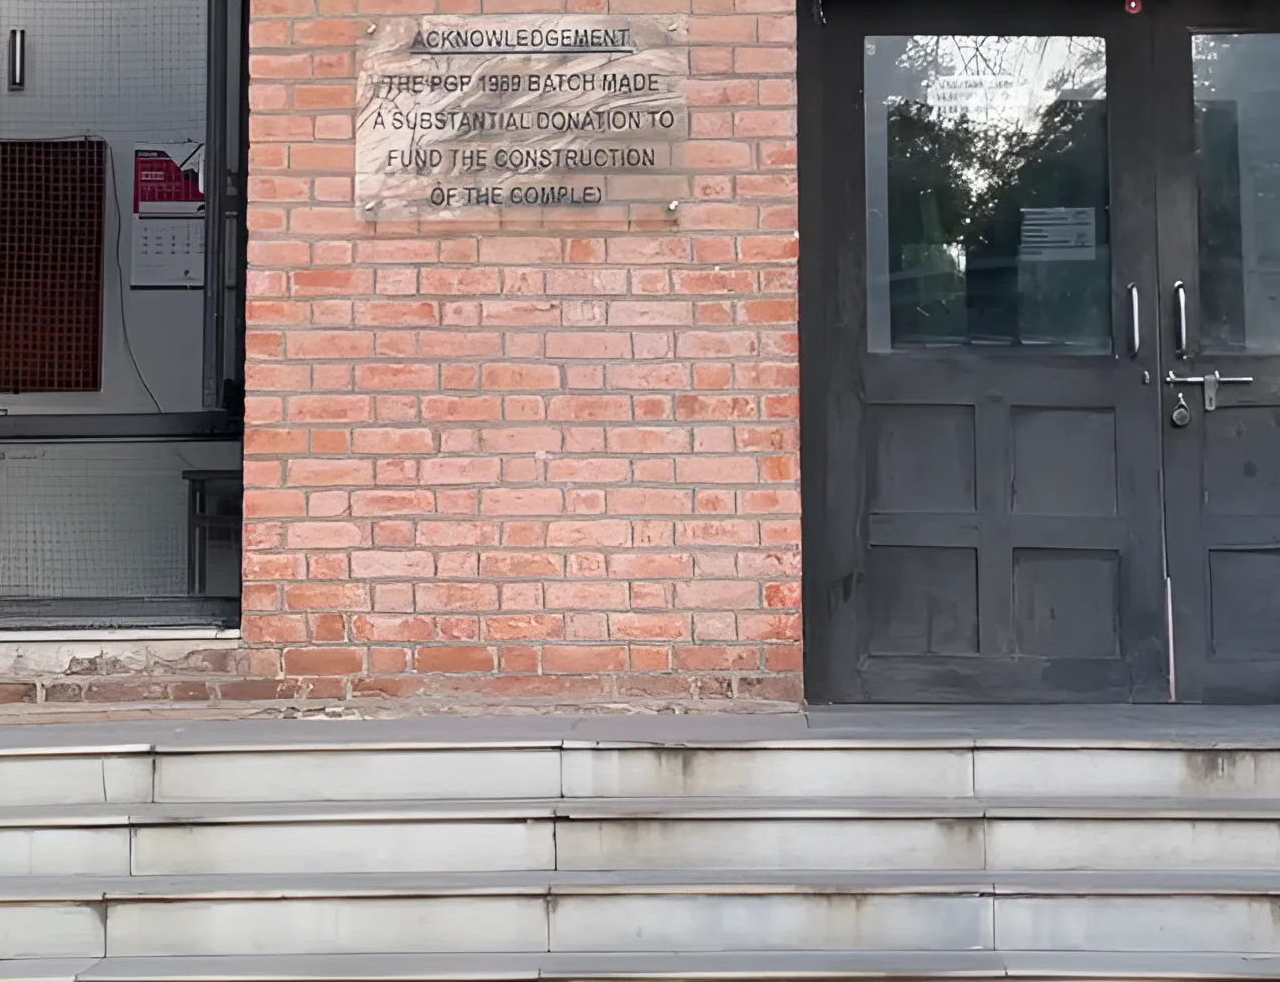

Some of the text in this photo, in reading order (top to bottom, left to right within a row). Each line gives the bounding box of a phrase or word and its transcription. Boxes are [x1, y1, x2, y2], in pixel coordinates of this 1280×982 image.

[412, 28, 630, 49] ACKNOWLEDGEMENT
[384, 74, 423, 93] THE
[528, 74, 594, 92] BATCH
[602, 73, 660, 92] MADE
[372, 110, 675, 131] A SUBSTANTIAL DONATION TO
[387, 148, 655, 168] FUND THE CONSTRUCTION
[430, 187, 458, 206] OF
[464, 187, 503, 205] THE
